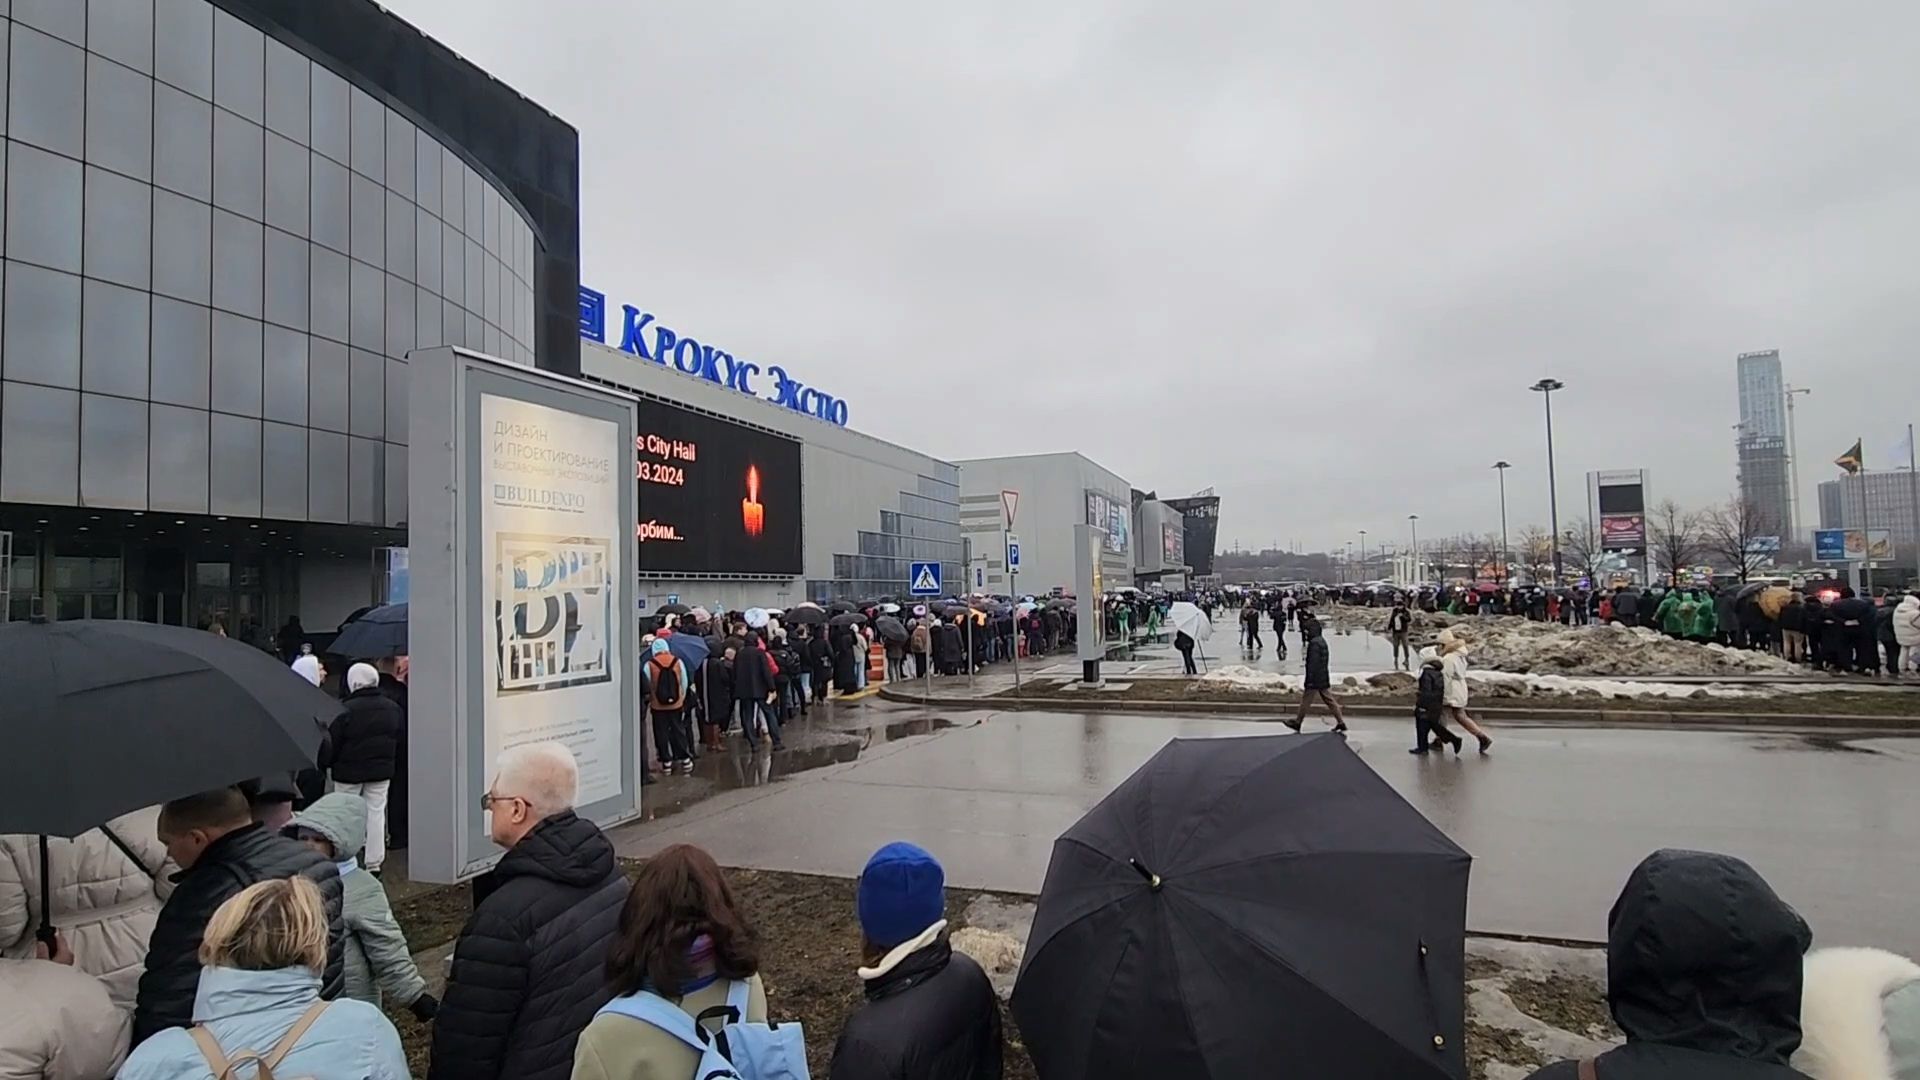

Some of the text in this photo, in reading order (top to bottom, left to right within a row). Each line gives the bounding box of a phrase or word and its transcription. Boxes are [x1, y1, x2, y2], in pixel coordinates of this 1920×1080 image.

[493, 420, 548, 442] ДИЗАЙН
[494, 441, 609, 472] И ПРОЕКТИРОВАНИЕ
[647, 434, 671, 460] City
[673, 440, 696, 461] Hall
[507, 485, 585, 508] BUILDEXPO
